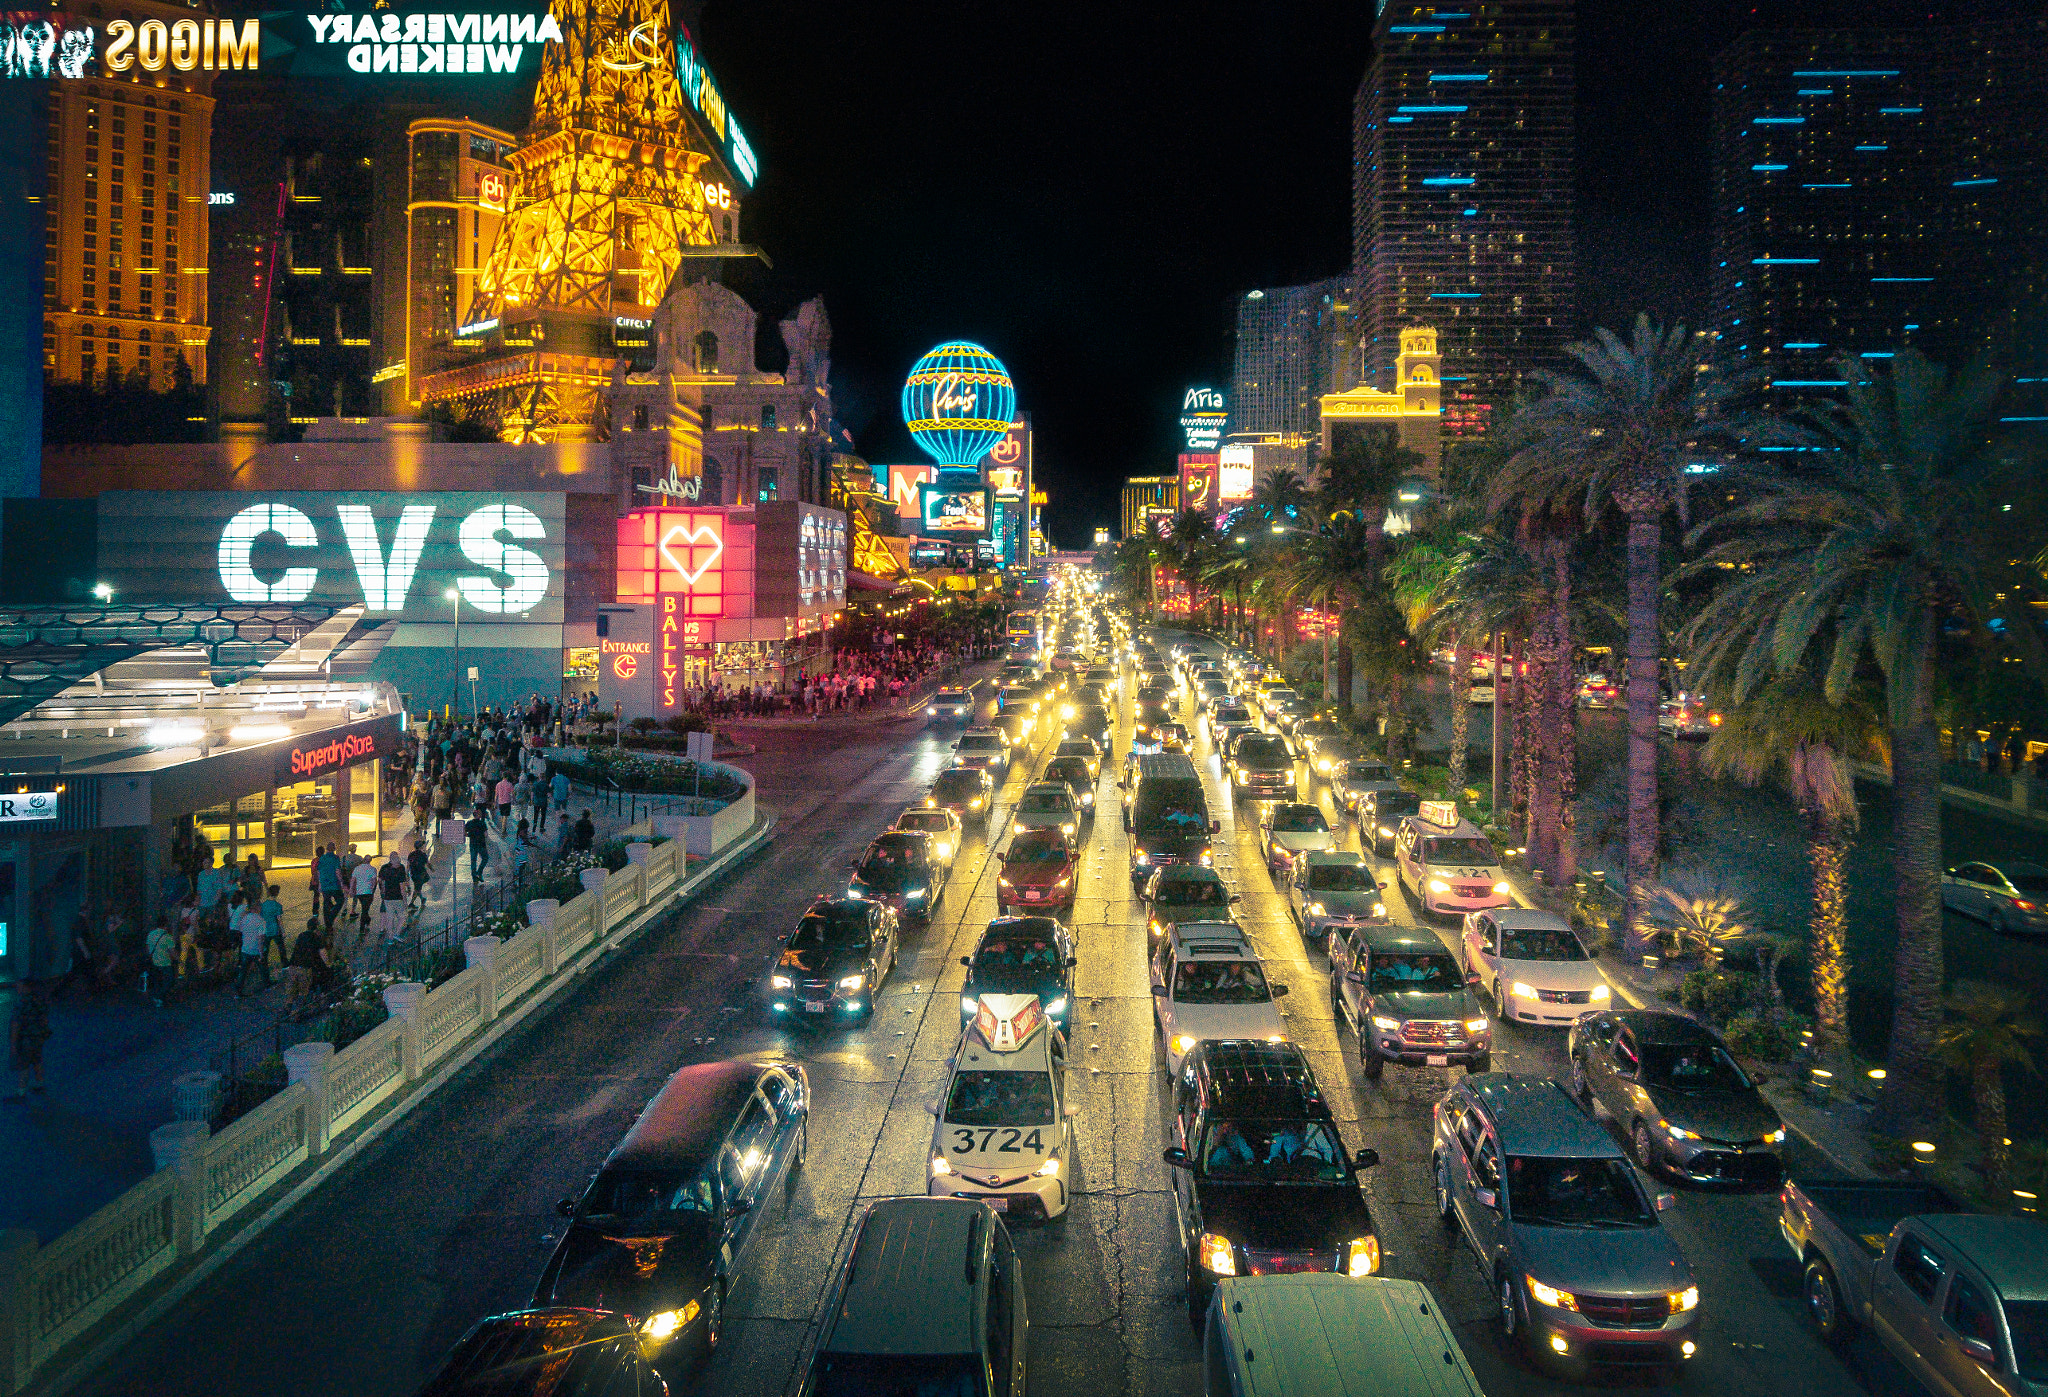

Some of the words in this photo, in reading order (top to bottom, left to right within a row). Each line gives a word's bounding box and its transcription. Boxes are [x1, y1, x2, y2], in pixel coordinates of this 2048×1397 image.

[933, 372, 977, 423] Paris
[1184, 388, 1223, 409] Aria
[1334, 402, 1399, 415] BELLAGIO
[218, 503, 550, 614] CVS
[662, 597, 677, 706] BALLYS
[952, 1129, 1045, 1155] 3724
